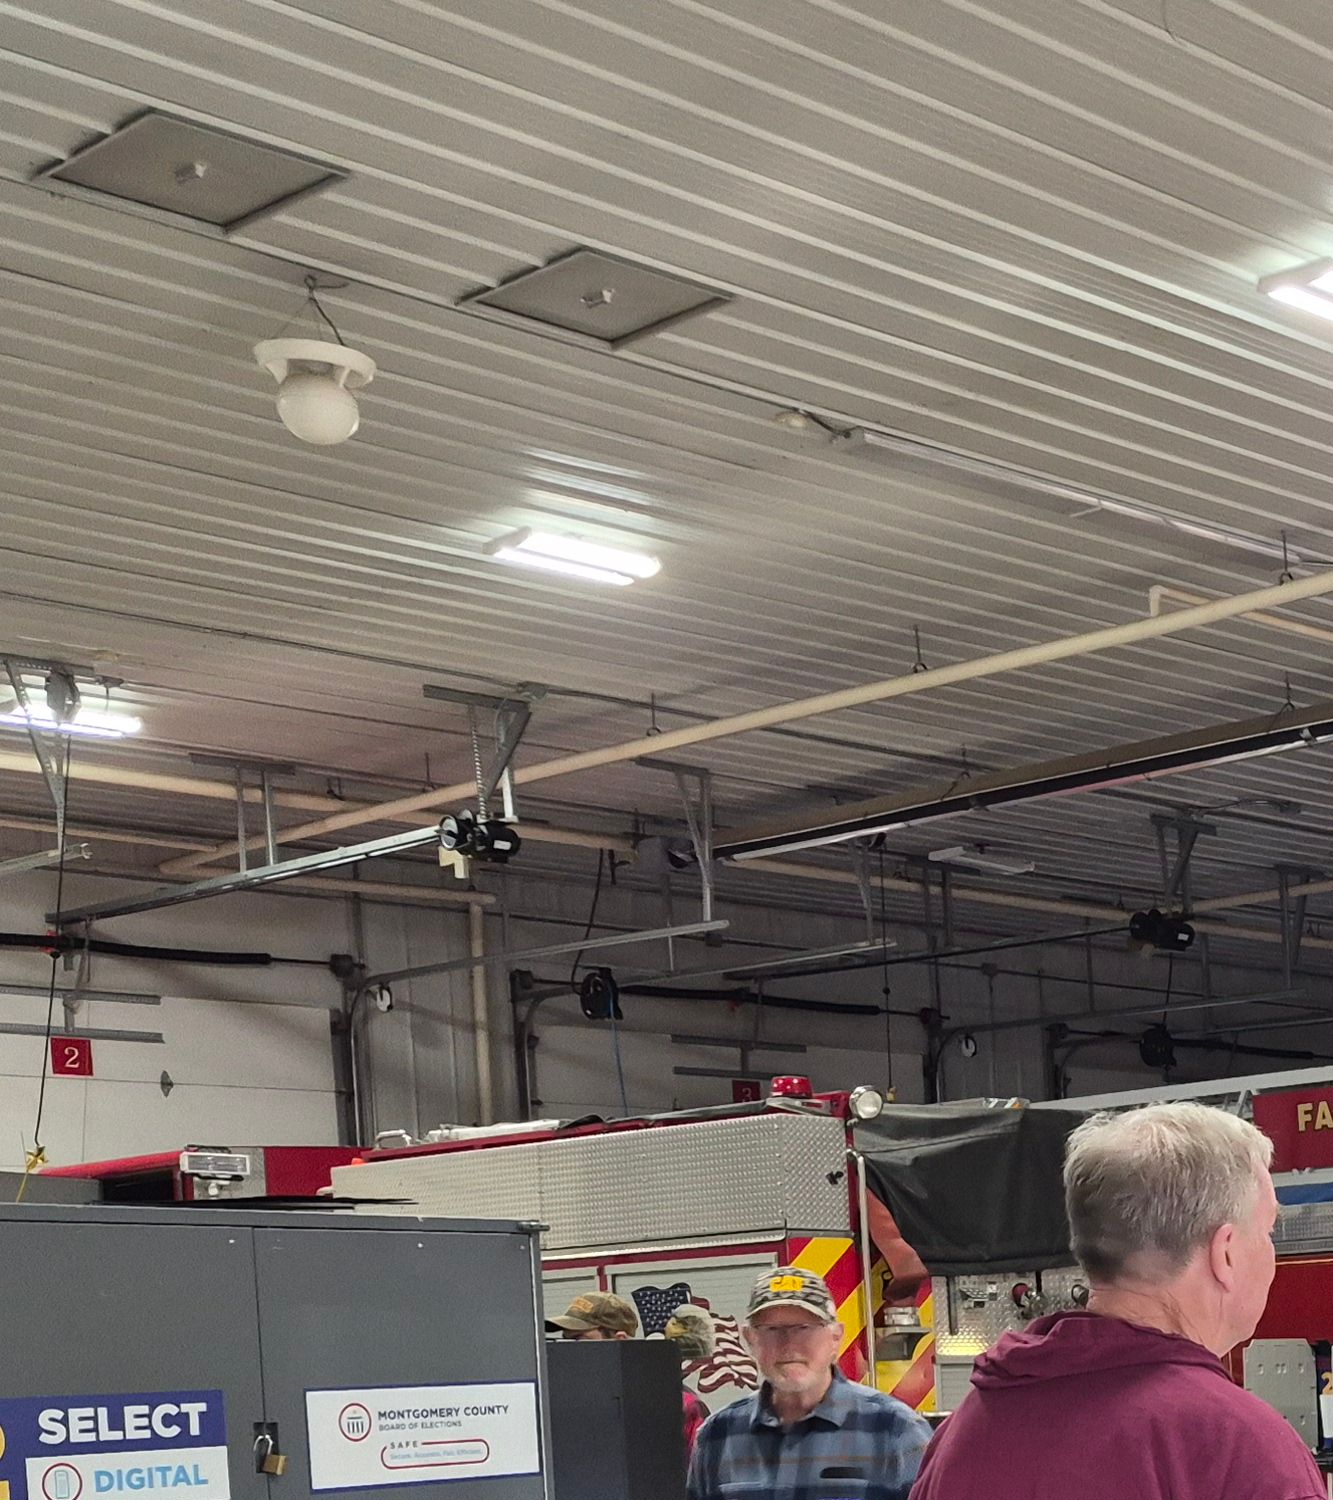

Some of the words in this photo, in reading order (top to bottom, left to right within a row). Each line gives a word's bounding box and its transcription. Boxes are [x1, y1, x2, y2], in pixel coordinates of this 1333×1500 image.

[64, 1046, 80, 1068] 2
[741, 1087, 753, 1103] 3
[378, 1407, 460, 1421] MONTGOMERY
[463, 1404, 509, 1418] COUNTY
[38, 1402, 207, 1445] SELECT
[378, 1422, 407, 1432] BOARD
[408, 1421, 419, 1430] OF
[421, 1420, 462, 1430] ELECTIONS
[390, 1440, 419, 1449] SAFE
[94, 1463, 209, 1493] DIGITAL
